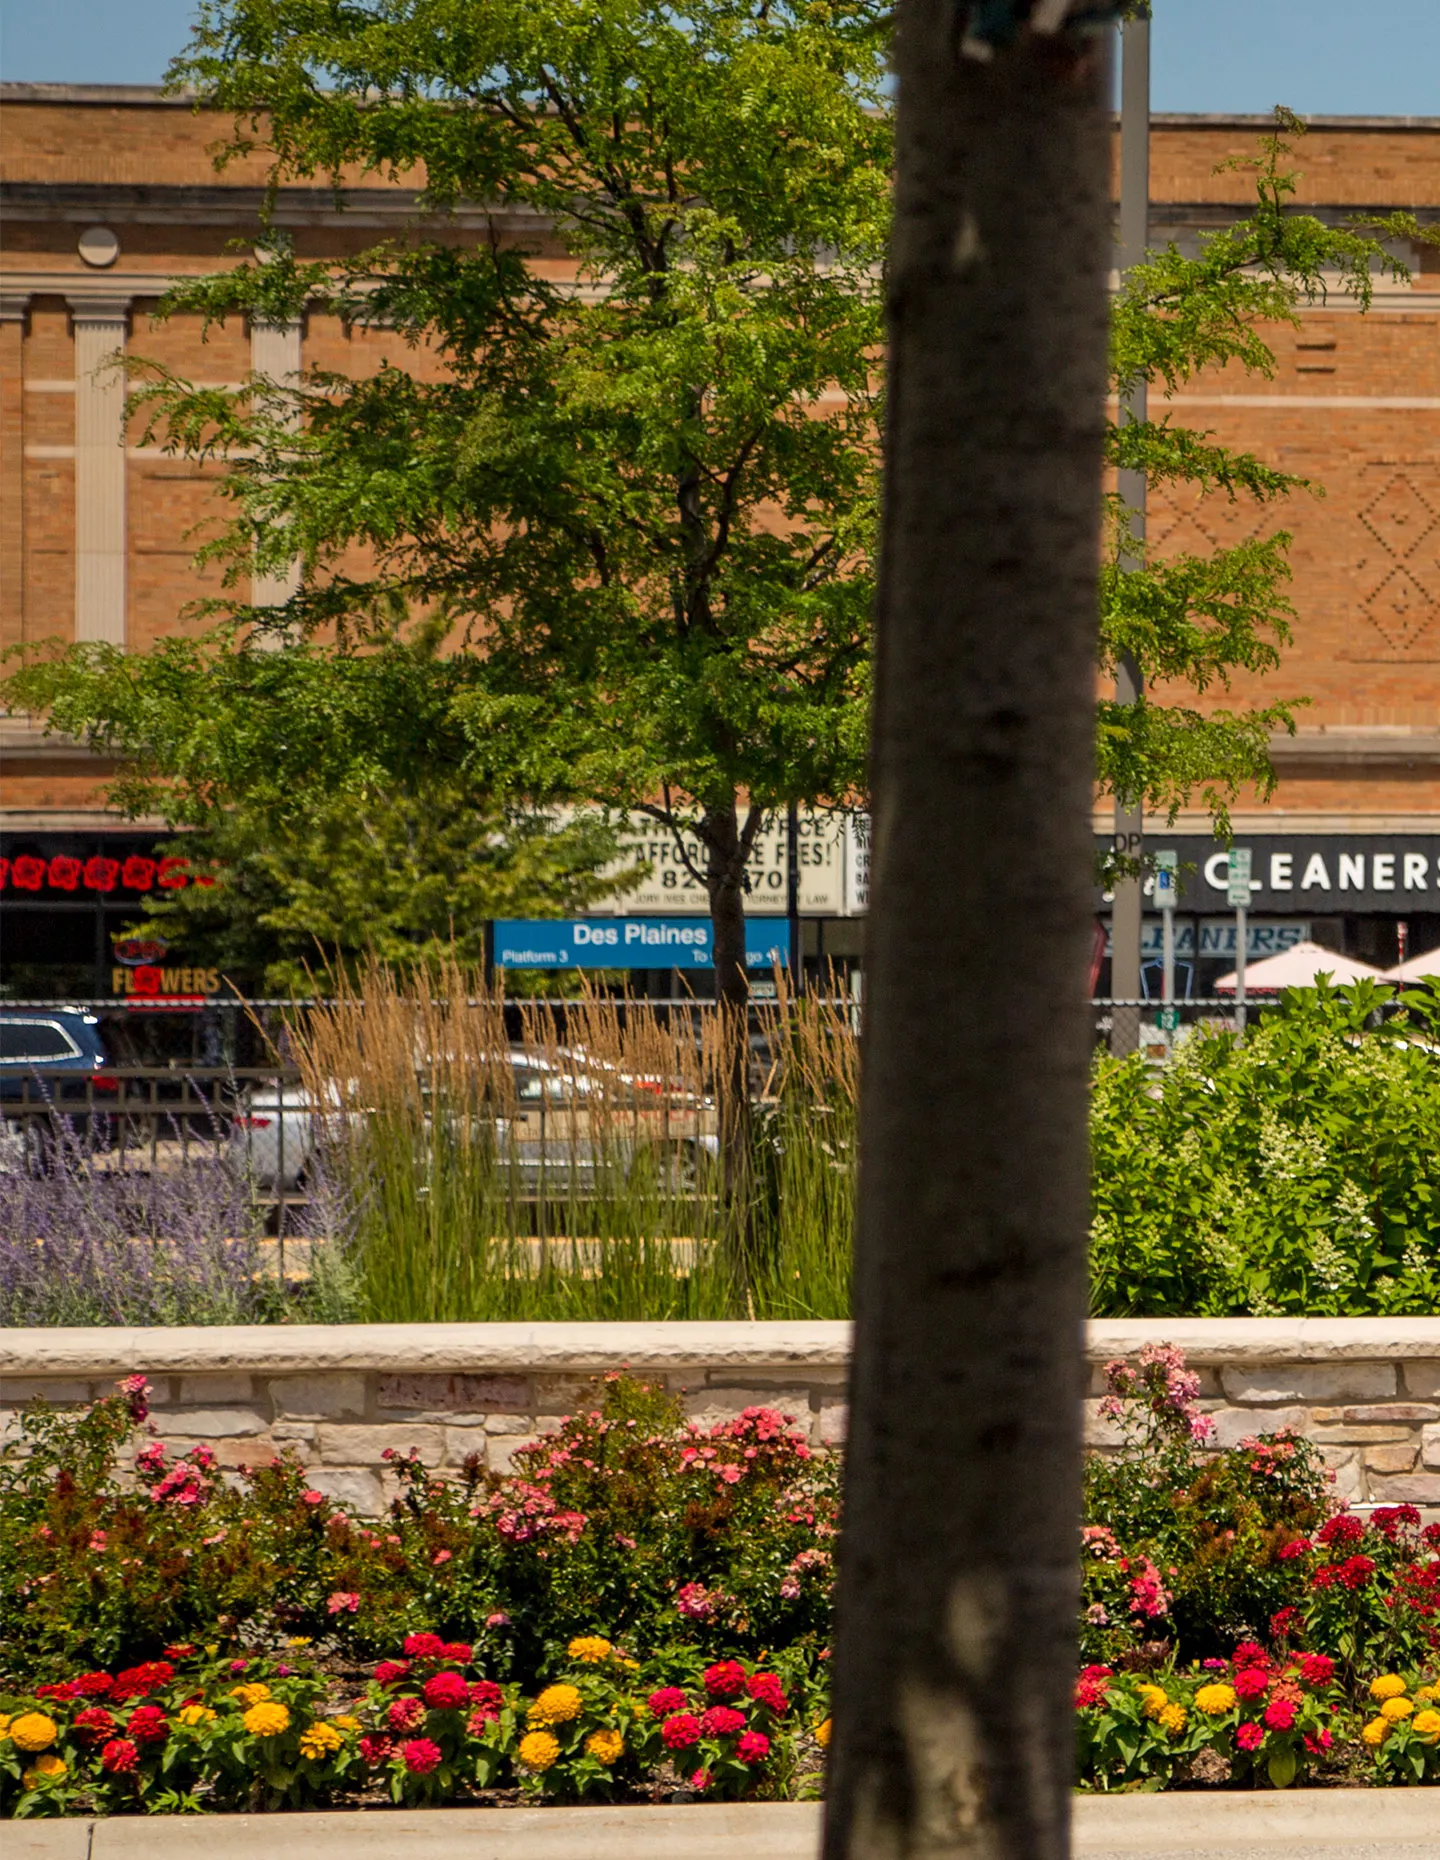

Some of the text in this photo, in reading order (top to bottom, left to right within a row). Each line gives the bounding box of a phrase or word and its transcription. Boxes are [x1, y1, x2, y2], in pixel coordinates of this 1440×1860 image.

[573, 923, 708, 945] Des Plaines
[502, 950, 556, 963] Platform
[558, 950, 569, 963] 3
[692, 950, 708, 963] To
